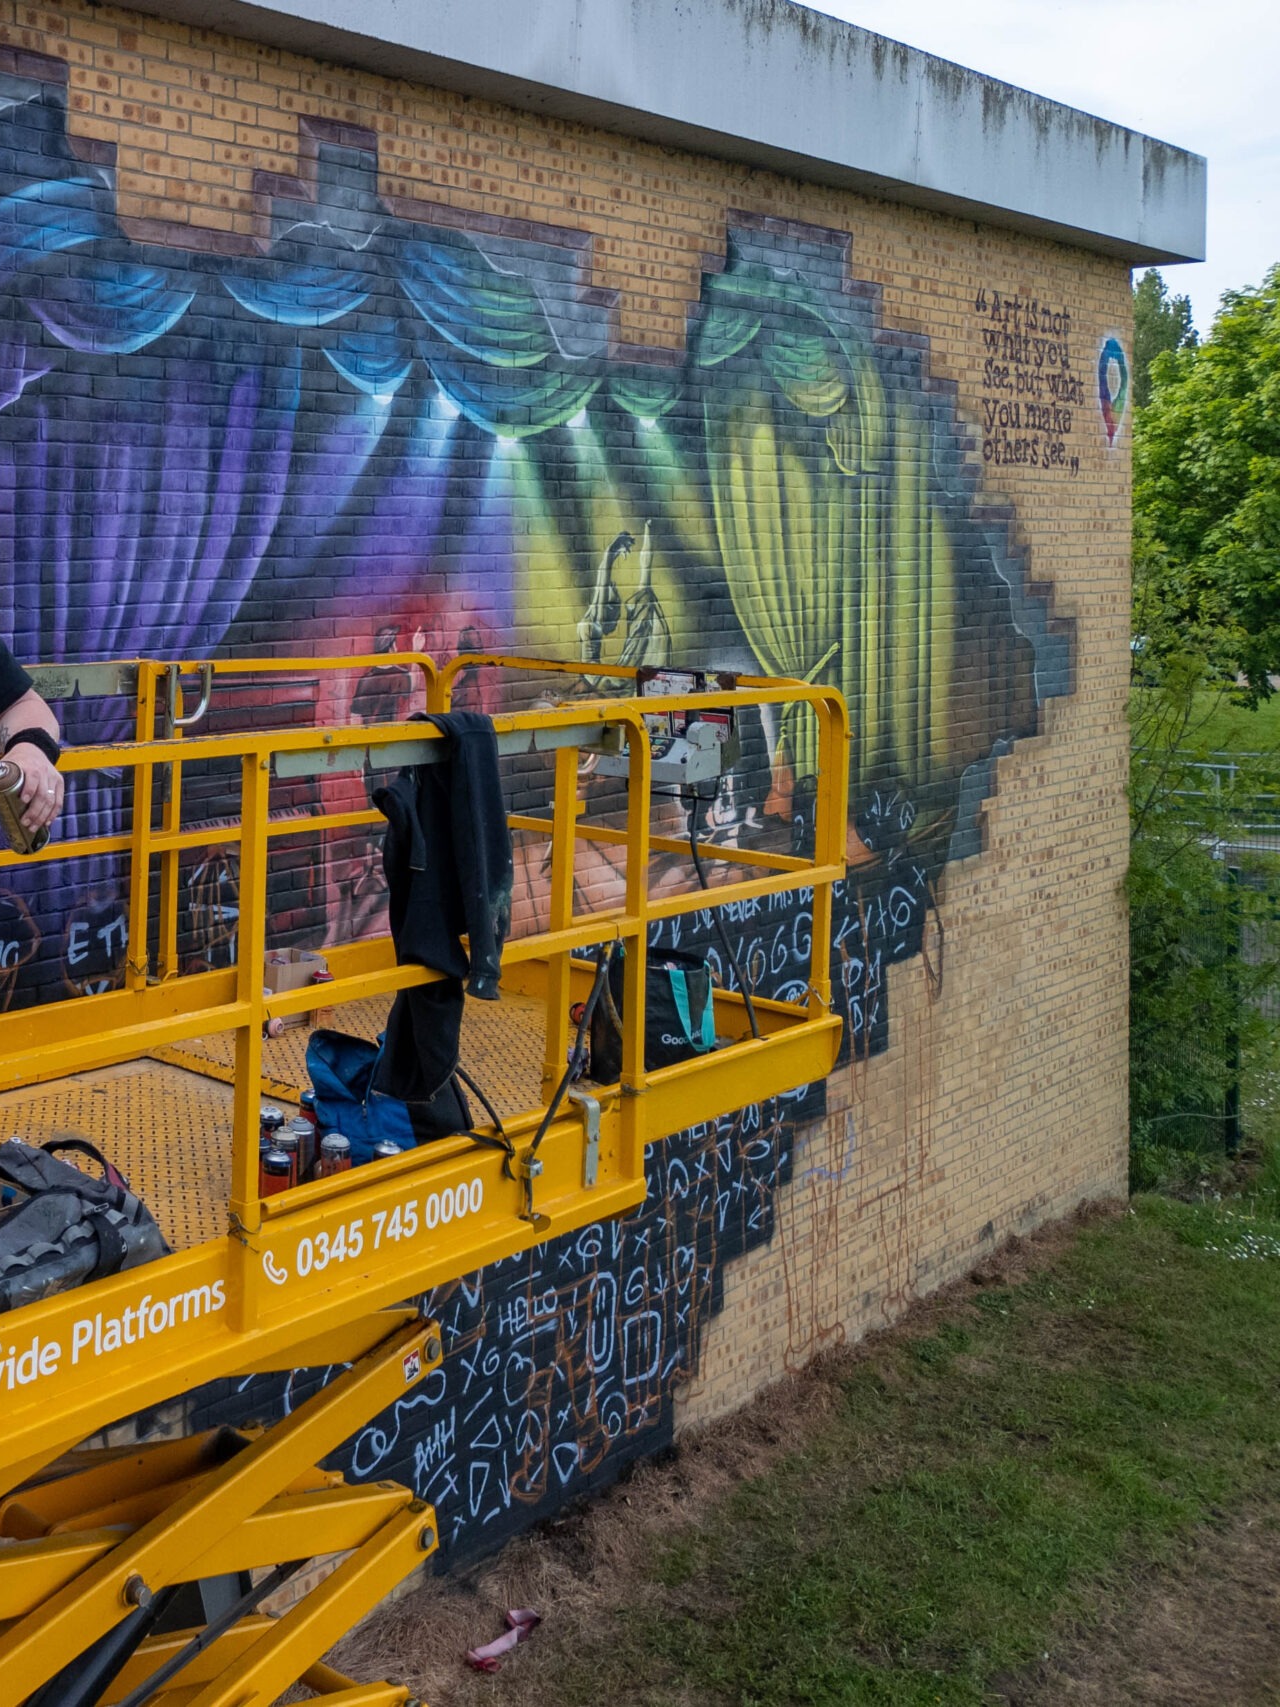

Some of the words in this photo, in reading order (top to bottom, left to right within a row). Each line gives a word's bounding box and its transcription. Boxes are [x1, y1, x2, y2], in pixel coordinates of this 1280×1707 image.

[1025, 298, 1038, 330] is
[1041, 307, 1071, 336] not
[982, 323, 1031, 365] what
[1033, 337, 1071, 369] you
[1016, 365, 1044, 398] but
[1046, 372, 1085, 406] what
[1024, 401, 1072, 434] make
[982, 428, 1039, 466] others
[296, 1219, 364, 1277] 0345
[371, 1200, 419, 1249] 745
[425, 1178, 483, 1230] 0000
[72, 1279, 226, 1365] Platforms
